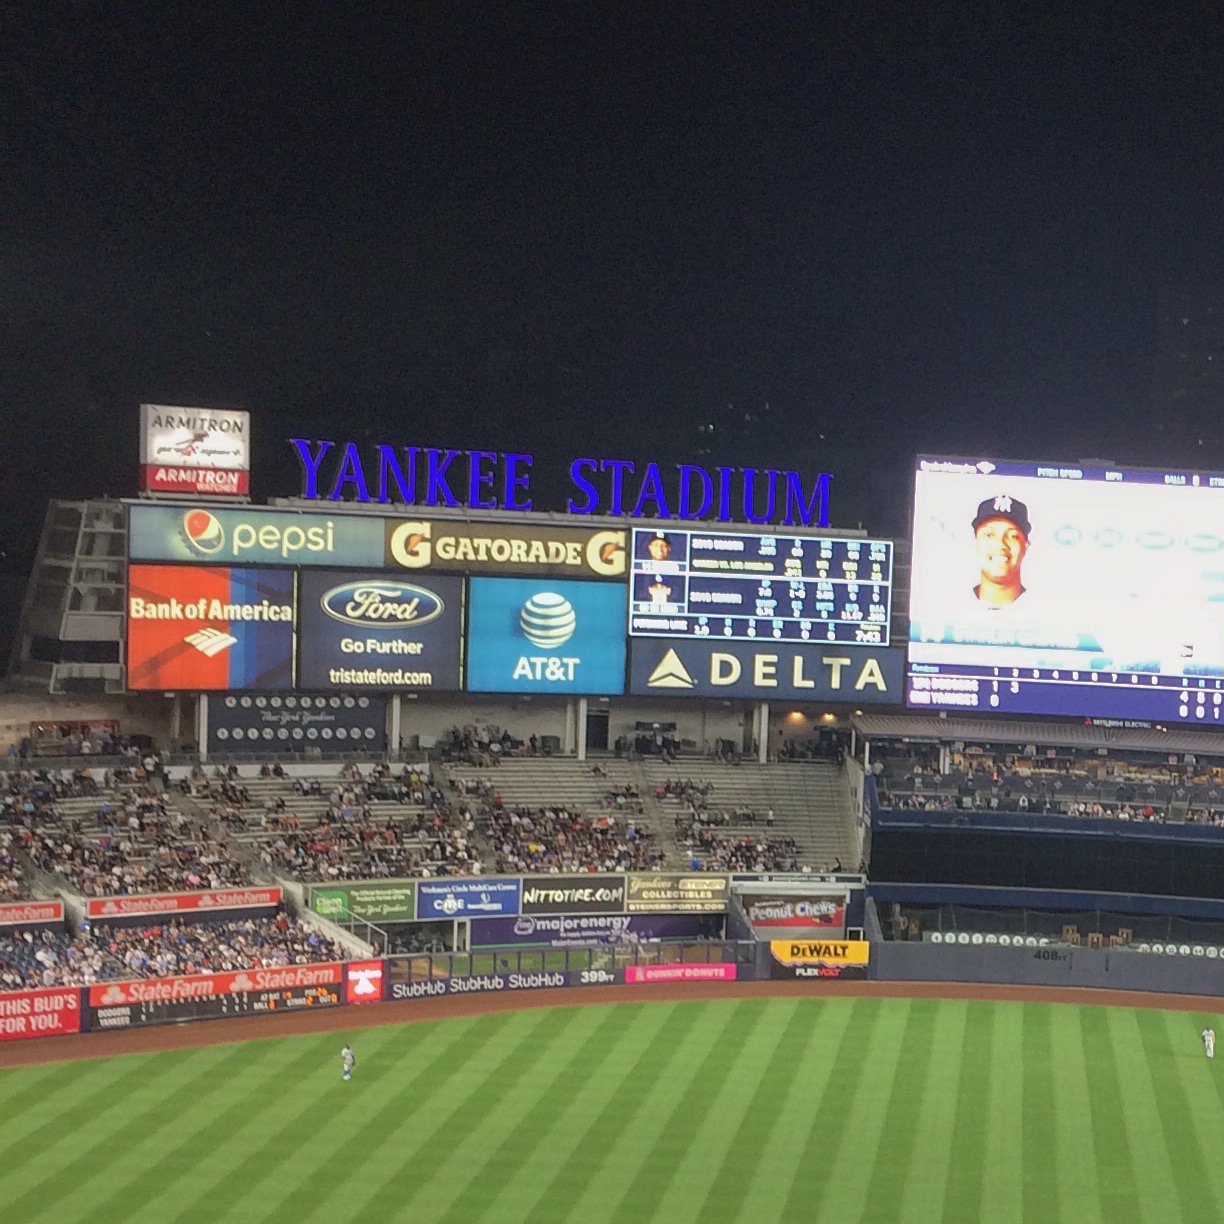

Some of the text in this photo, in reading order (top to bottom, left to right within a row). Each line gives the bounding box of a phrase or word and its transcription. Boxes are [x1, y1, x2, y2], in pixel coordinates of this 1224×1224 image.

[152, 415, 243, 433] ARMITRON
[155, 467, 239, 485] ARMITRON
[289, 439, 834, 528] YANKEE STADIUM
[232, 521, 334, 558] pepsi
[391, 522, 626, 576] G GATORADE G
[130, 598, 292, 621] Bank of America
[345, 588, 418, 620] Ford
[340, 639, 423, 655] Go Further
[330, 668, 432, 685] tristateford.com
[513, 656, 581, 681] AT&T
[710, 652, 888, 692] DELTA
[524, 887, 623, 904] NITTOTIRE.COM
[642, 891, 713, 899] COLLECTIBLES
[749, 904, 795, 921] Peanut
[796, 901, 837, 917] Chews
[536, 917, 631, 932] majorenergy
[509, 973, 565, 989] StubHub
[684, 968, 725, 977] DONUTS
[393, 981, 445, 999] StubHub
[450, 976, 504, 992] StubHub
[34, 994, 77, 1013] BUD'S
[0, 1016, 63, 1034] FOR YOU.
